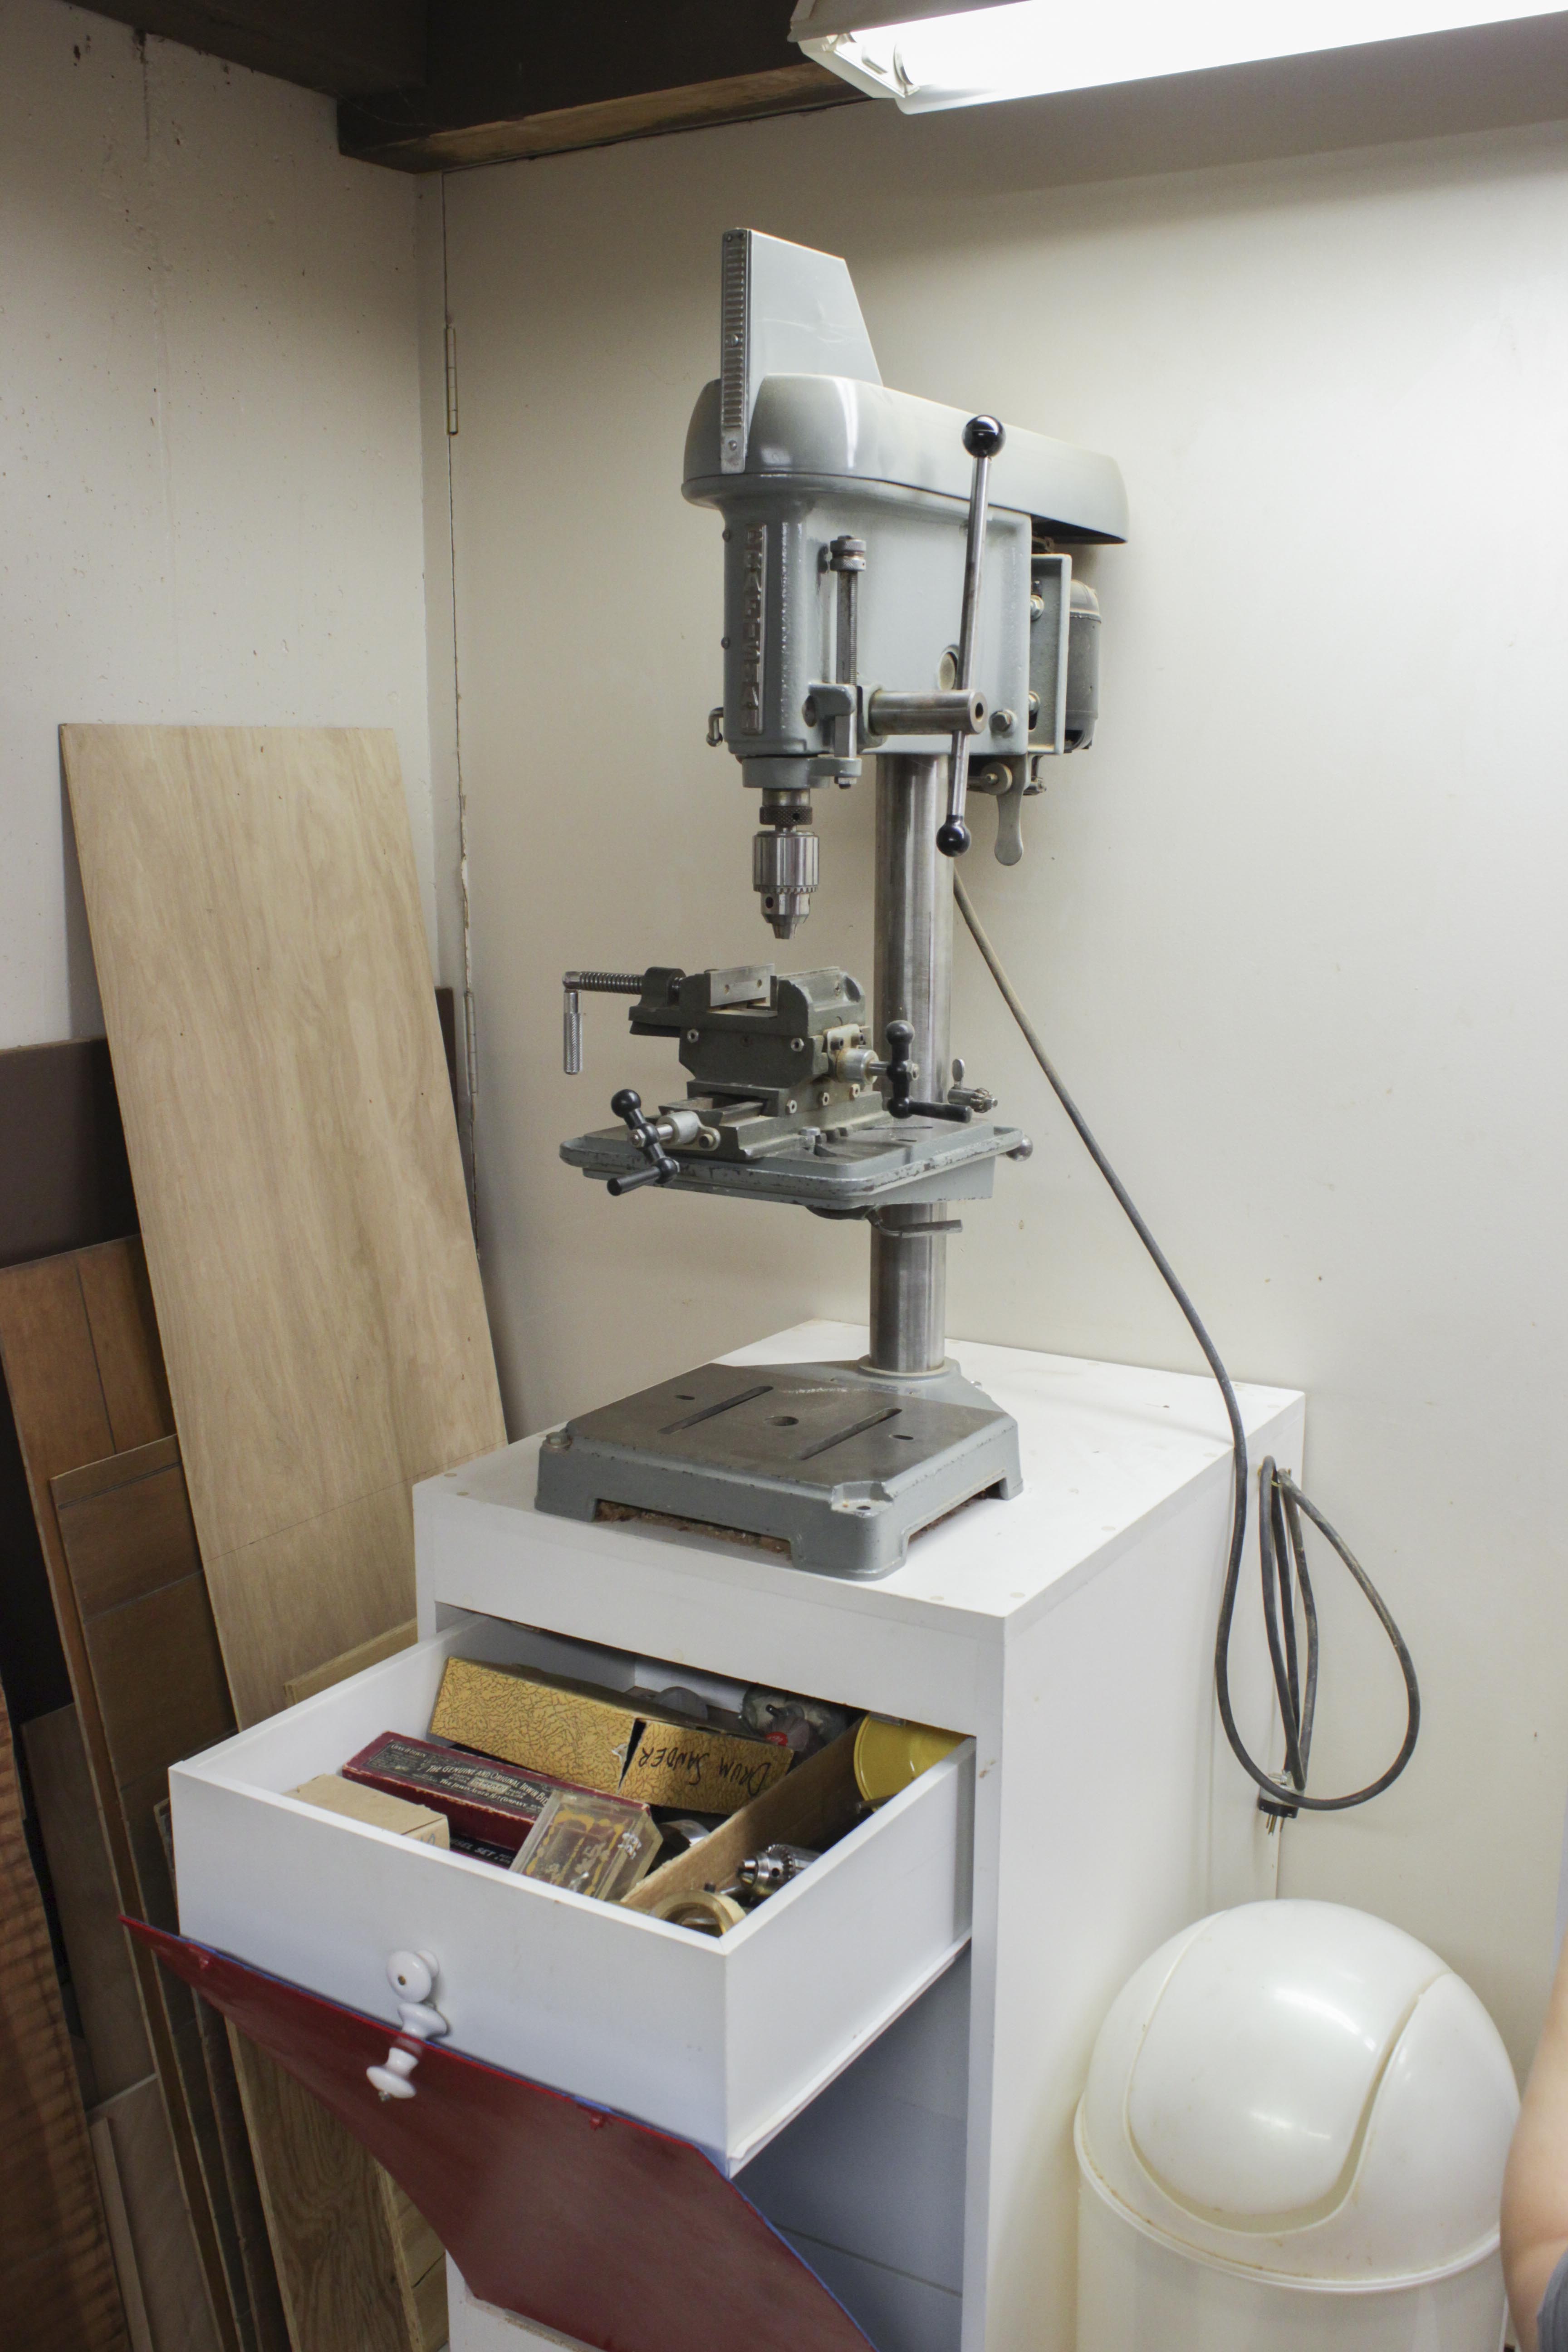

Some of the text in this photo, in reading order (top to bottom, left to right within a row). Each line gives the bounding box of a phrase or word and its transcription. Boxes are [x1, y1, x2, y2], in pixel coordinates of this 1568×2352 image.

[426, 1765, 442, 1773] THE
[442, 1765, 475, 1775] GENUINE
[490, 1772, 520, 1788] ORIGINAL
[519, 1782, 539, 1798] IRWIN
[638, 1747, 771, 1798] DRUM SANDER
